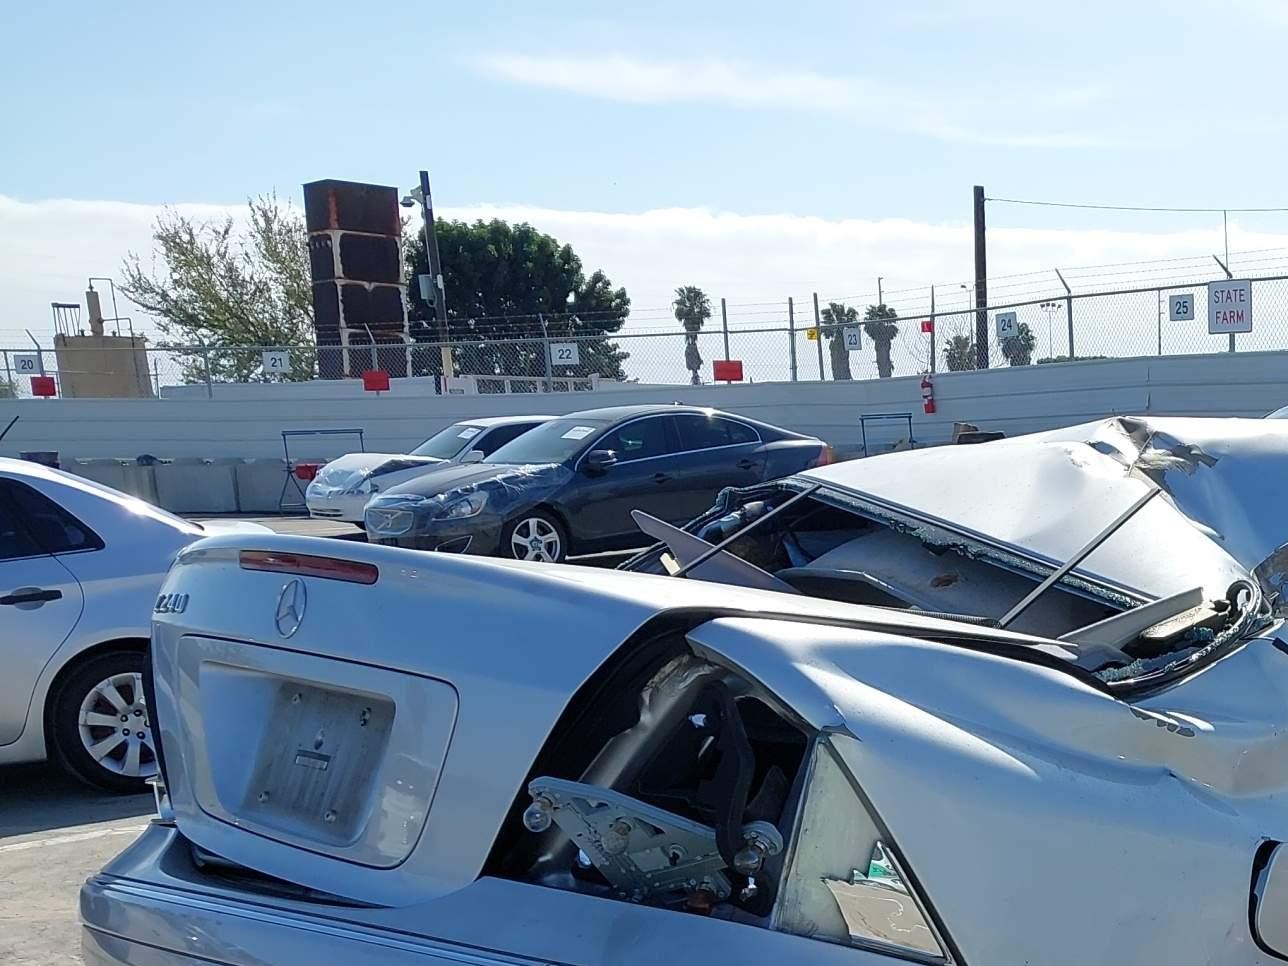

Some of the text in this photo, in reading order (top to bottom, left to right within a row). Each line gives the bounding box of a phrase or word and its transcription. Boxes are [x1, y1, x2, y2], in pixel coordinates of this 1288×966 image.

[1214, 289, 1246, 304] STATE
[1175, 301, 1189, 315] 25
[1215, 309, 1244, 325] FARM
[1001, 319, 1012, 331] 24
[847, 334, 858, 345] 23
[558, 348, 572, 360] 22
[20, 359, 33, 370] 20
[270, 357, 283, 368] 21
